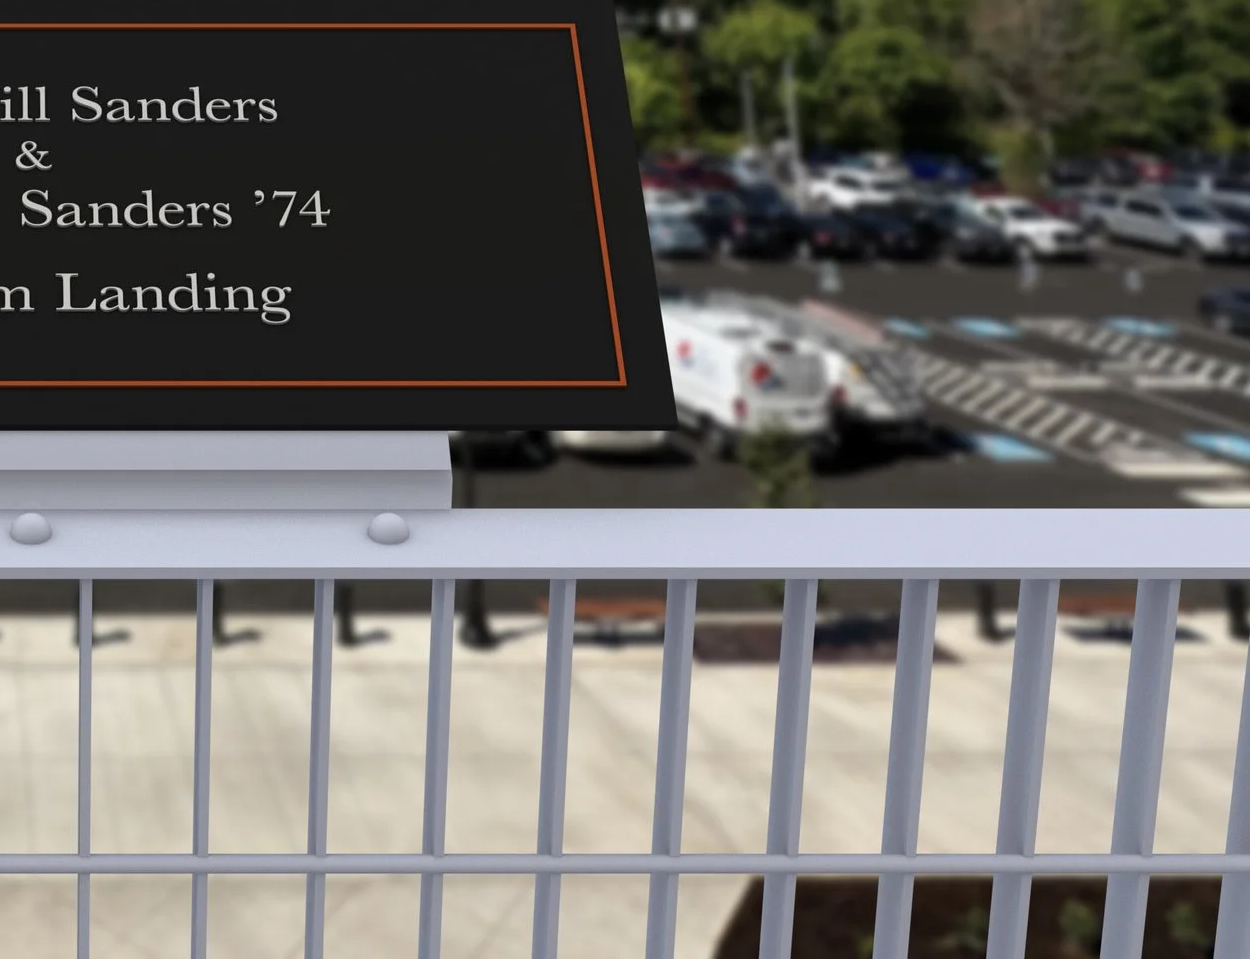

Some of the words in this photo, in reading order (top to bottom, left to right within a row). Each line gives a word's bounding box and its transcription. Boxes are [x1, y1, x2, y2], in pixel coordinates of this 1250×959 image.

[71, 85, 278, 122] Sanders
[15, 140, 53, 171] &
[21, 189, 233, 227] Sanders
[254, 189, 331, 228] ’74
[55, 272, 293, 324] Landing
